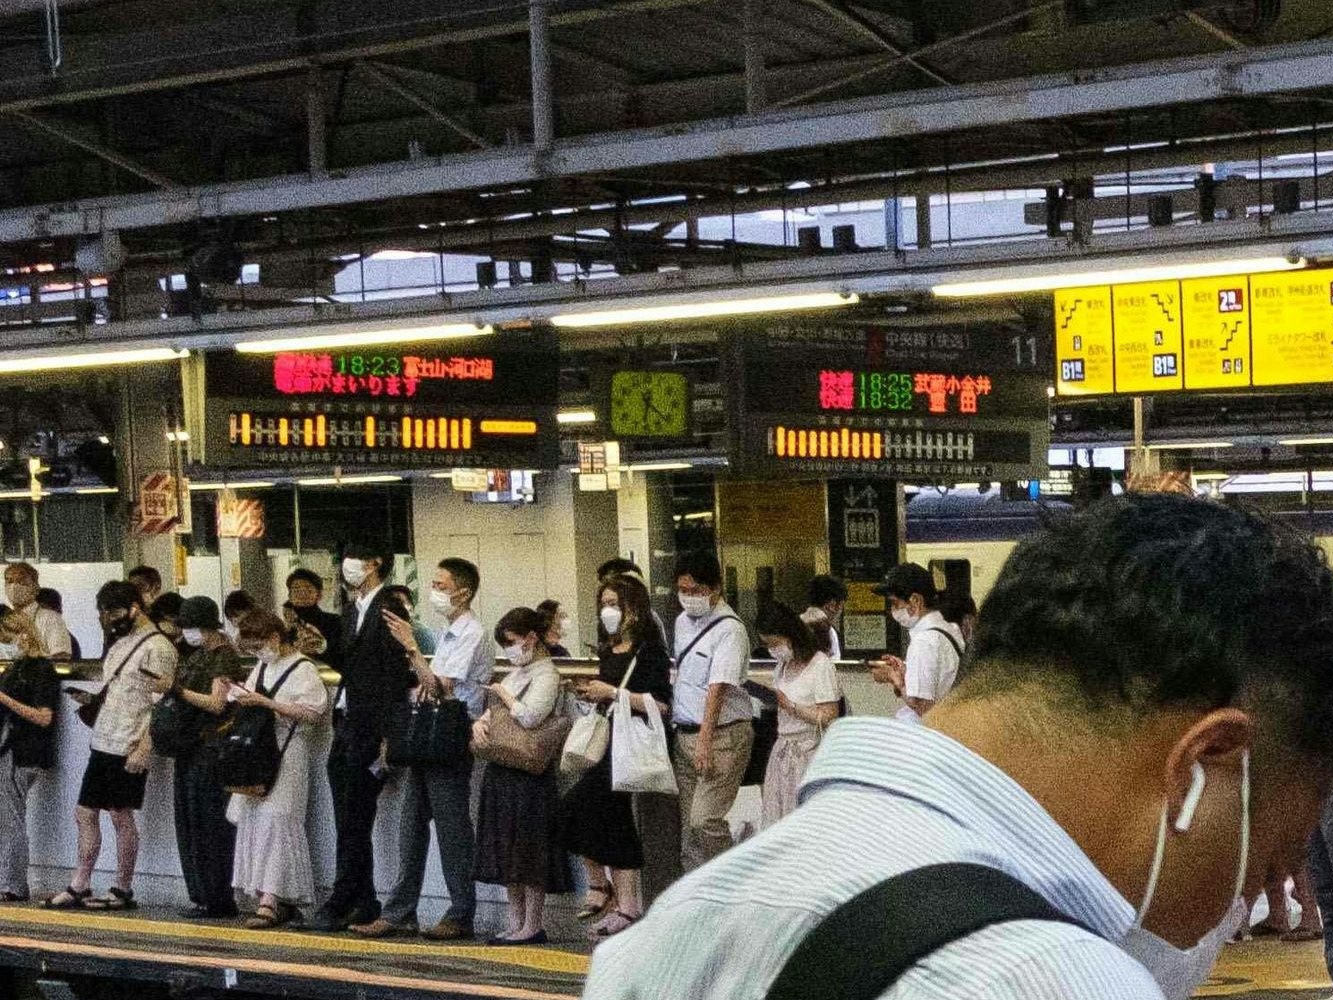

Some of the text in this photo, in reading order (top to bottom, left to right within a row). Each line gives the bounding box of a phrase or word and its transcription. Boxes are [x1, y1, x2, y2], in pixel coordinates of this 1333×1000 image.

[1011, 336, 1037, 366] 11
[337, 356, 400, 375] 18:23
[860, 372, 912, 391] 18:25
[914, 374, 991, 395] 武蔵小金井
[860, 391, 912, 410] 18:32
